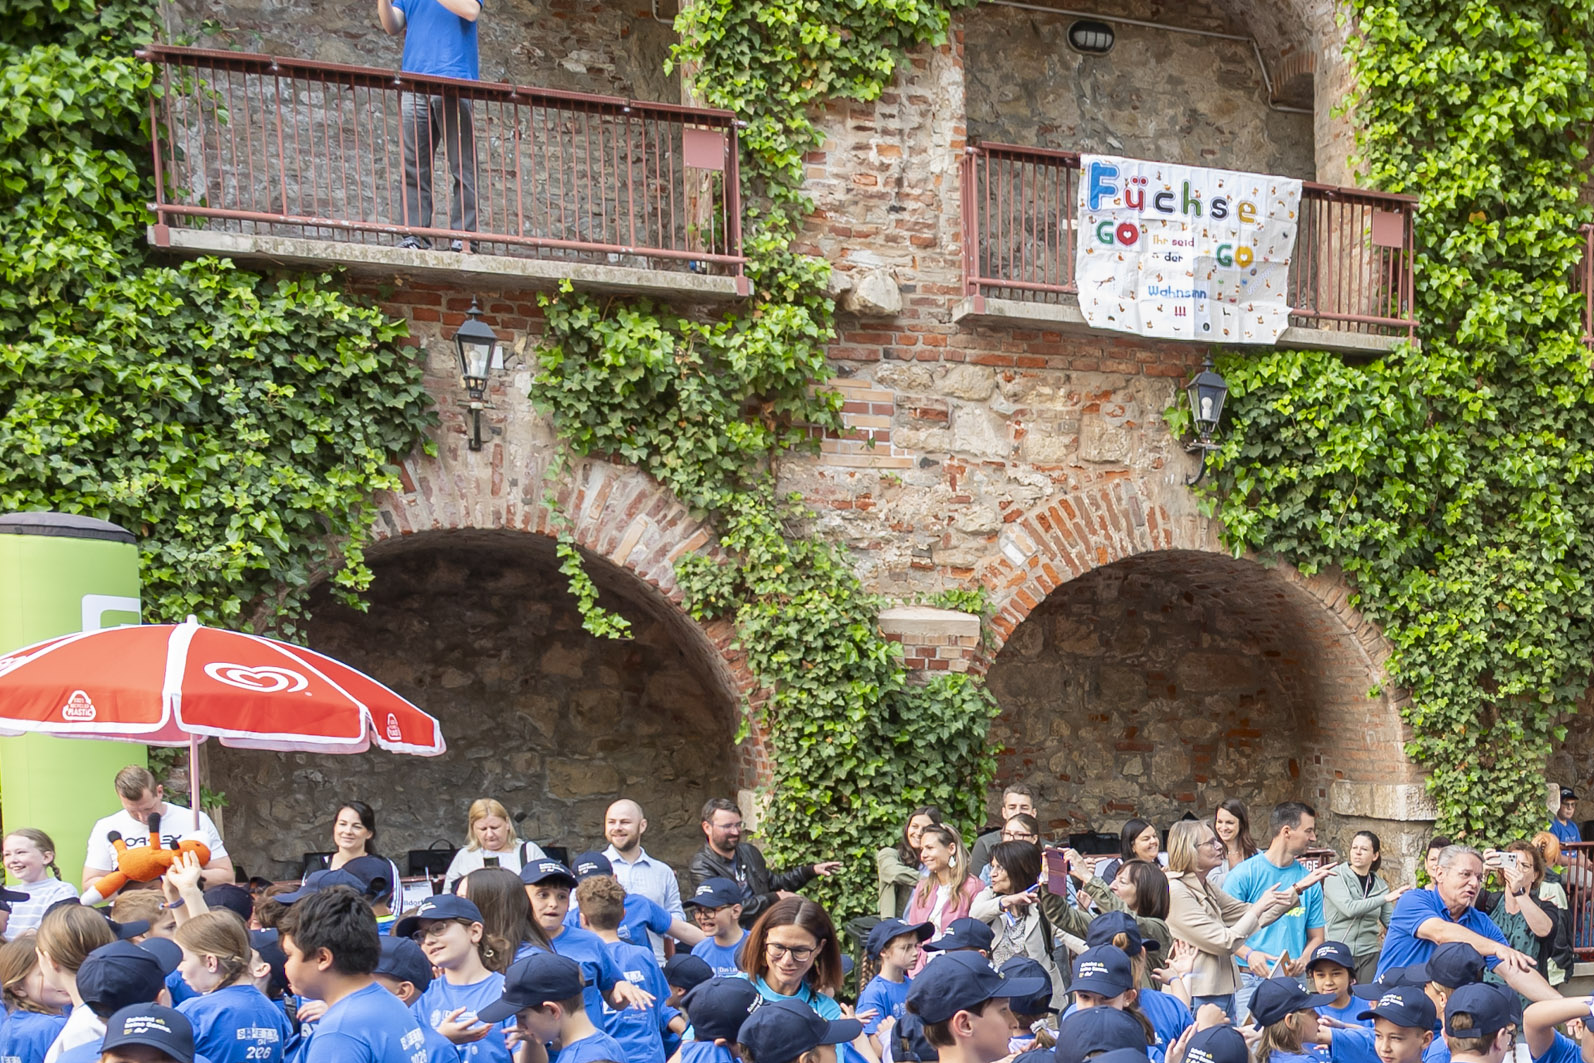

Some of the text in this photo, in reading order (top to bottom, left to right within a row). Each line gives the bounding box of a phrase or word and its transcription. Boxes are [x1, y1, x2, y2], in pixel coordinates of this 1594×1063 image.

[1088, 161, 1258, 224] Füchse
[1096, 220, 1139, 246] GO
[1152, 234, 1195, 247] Ihr seid
[1164, 252, 1183, 263] der
[1216, 244, 1254, 269] GO
